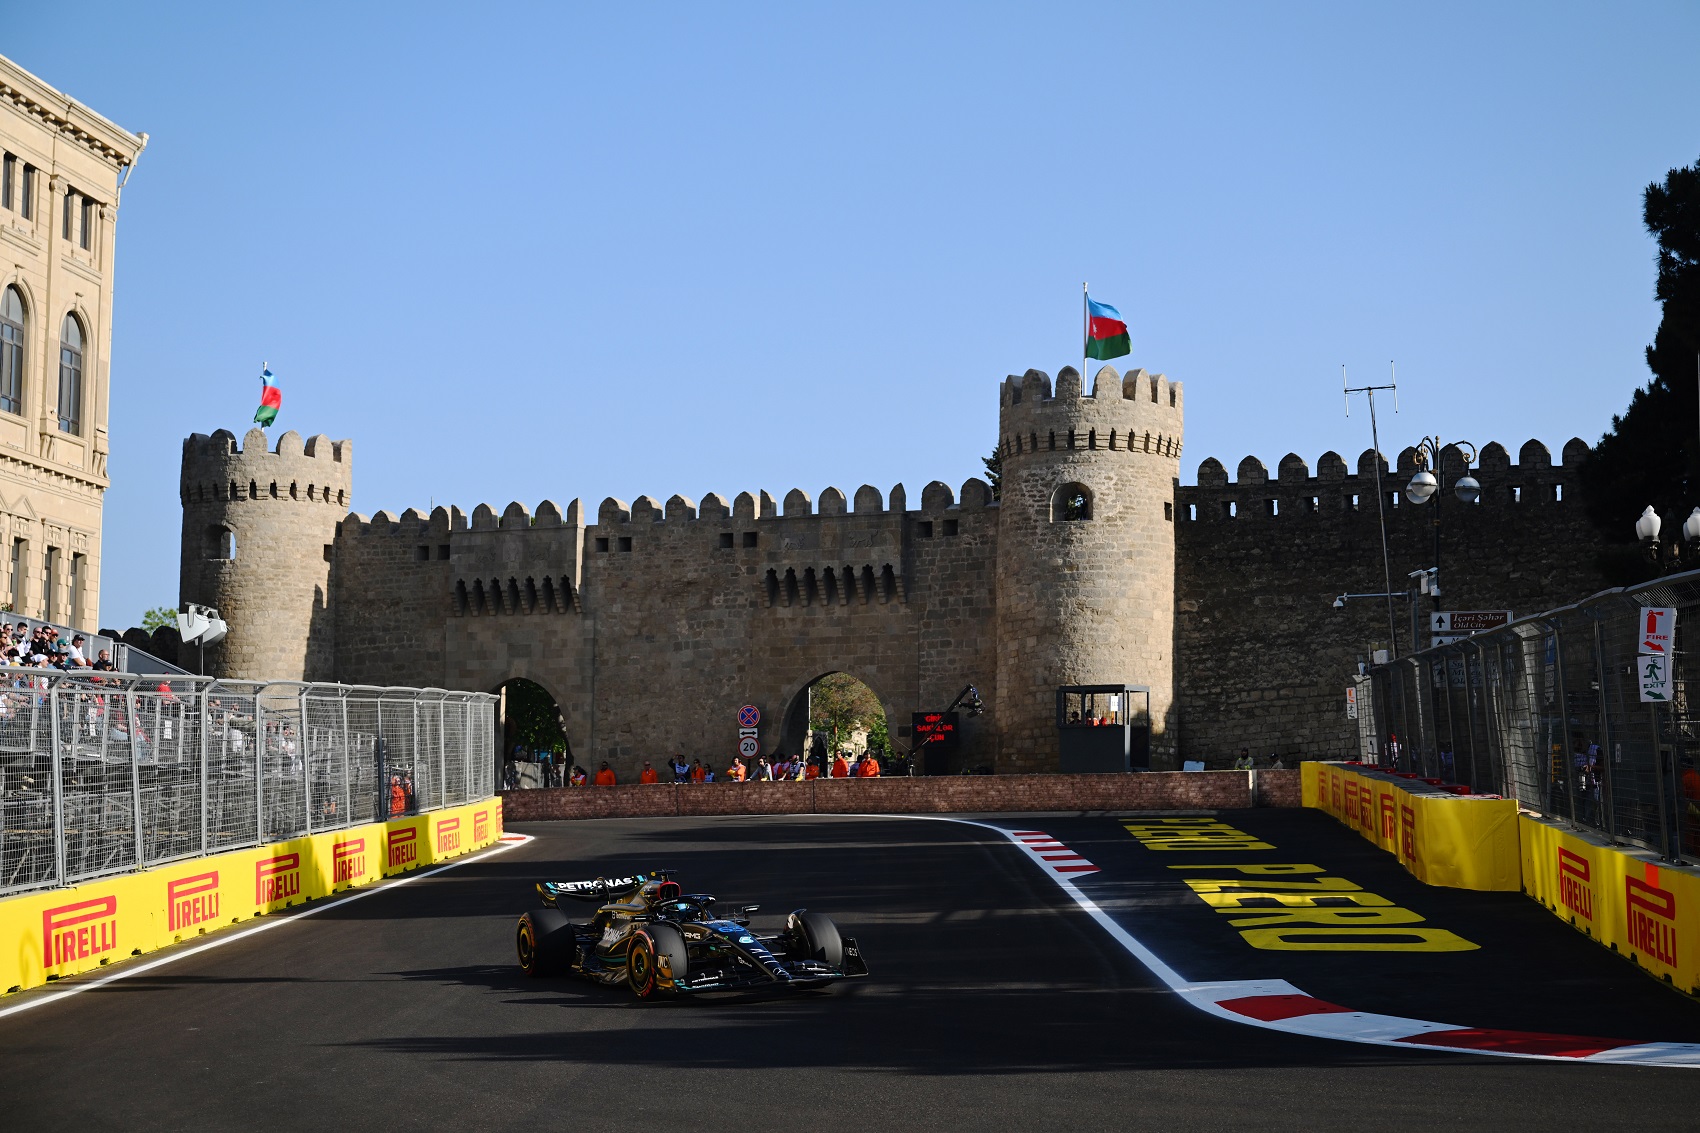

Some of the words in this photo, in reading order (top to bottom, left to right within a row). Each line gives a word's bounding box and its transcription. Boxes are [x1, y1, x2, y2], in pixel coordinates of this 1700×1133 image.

[1470, 622, 1486, 630] City
[743, 742, 756, 752] 20
[388, 827, 417, 868] PIRELLI
[437, 817, 460, 854] PIRELLI
[255, 852, 300, 906] PIRELLI
[333, 838, 365, 883] PIRELLI
[1166, 863, 1327, 875] P
[1558, 846, 1593, 922] PIRELLI
[168, 870, 219, 932] PIRELLI
[1182, 877, 1482, 952] ZERO
[1625, 874, 1678, 969] PIRELLI
[42, 895, 117, 968] PIRELLI
